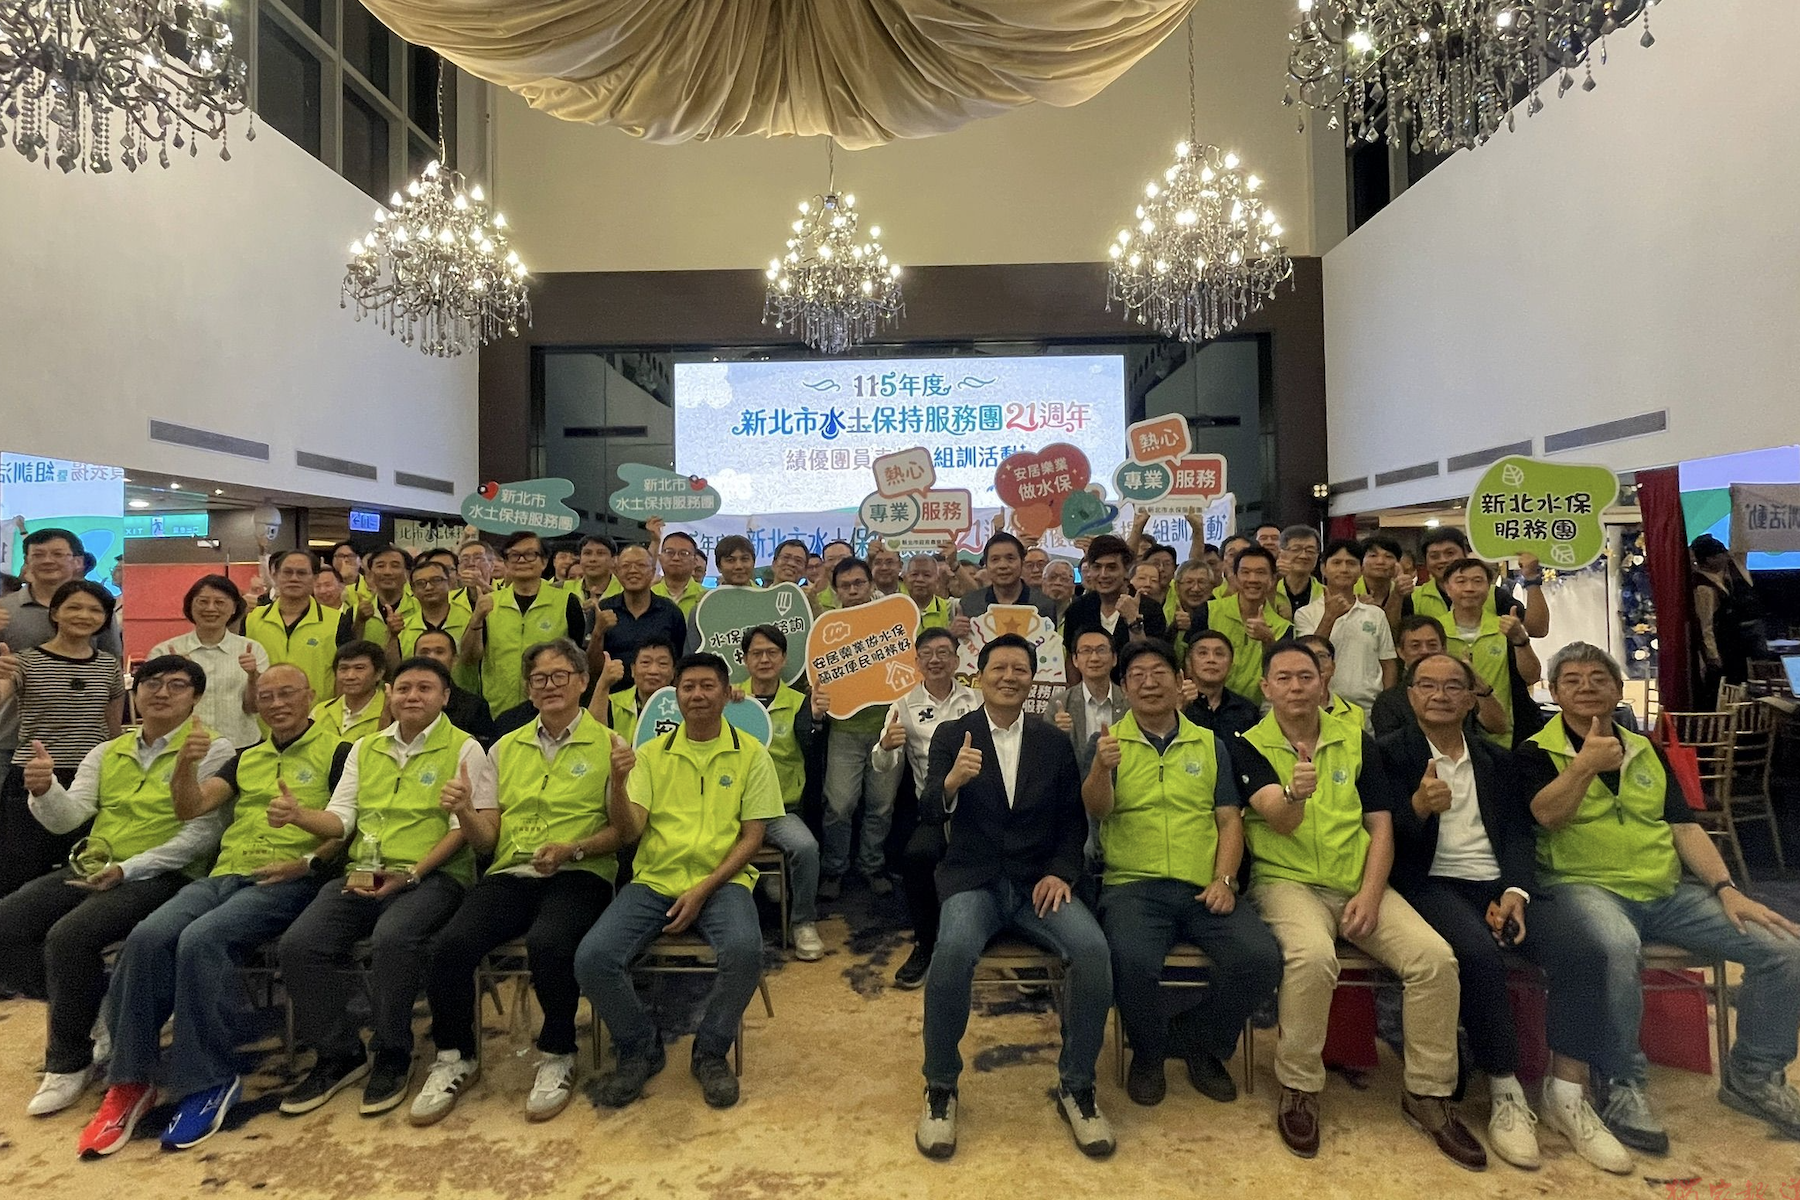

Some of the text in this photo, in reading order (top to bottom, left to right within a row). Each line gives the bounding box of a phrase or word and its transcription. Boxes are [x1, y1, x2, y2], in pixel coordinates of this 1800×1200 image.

[854, 371, 951, 397] 115年度
[731, 402, 1092, 439] 新北市水土保持服務團21週年
[1139, 428, 1180, 453] 熱心
[885, 461, 925, 486] 熱心
[1013, 457, 1068, 481] 安居樂業
[1124, 470, 1163, 490] 專業
[1175, 469, 1216, 489] 服務
[644, 478, 686, 492] 新北市
[1018, 474, 1073, 501] 做水保
[501, 489, 546, 508] 新北市
[616, 495, 715, 511] 水土保持服務團
[1481, 493, 1591, 514] 新北水保
[468, 505, 573, 531] 水土保持服務團
[869, 502, 909, 523] 專業
[921, 501, 962, 521] 服務
[1153, 515, 1223, 542] 組訓動
[1495, 519, 1577, 540] 服務團
[812, 623, 906, 669] 安居樂業做水保
